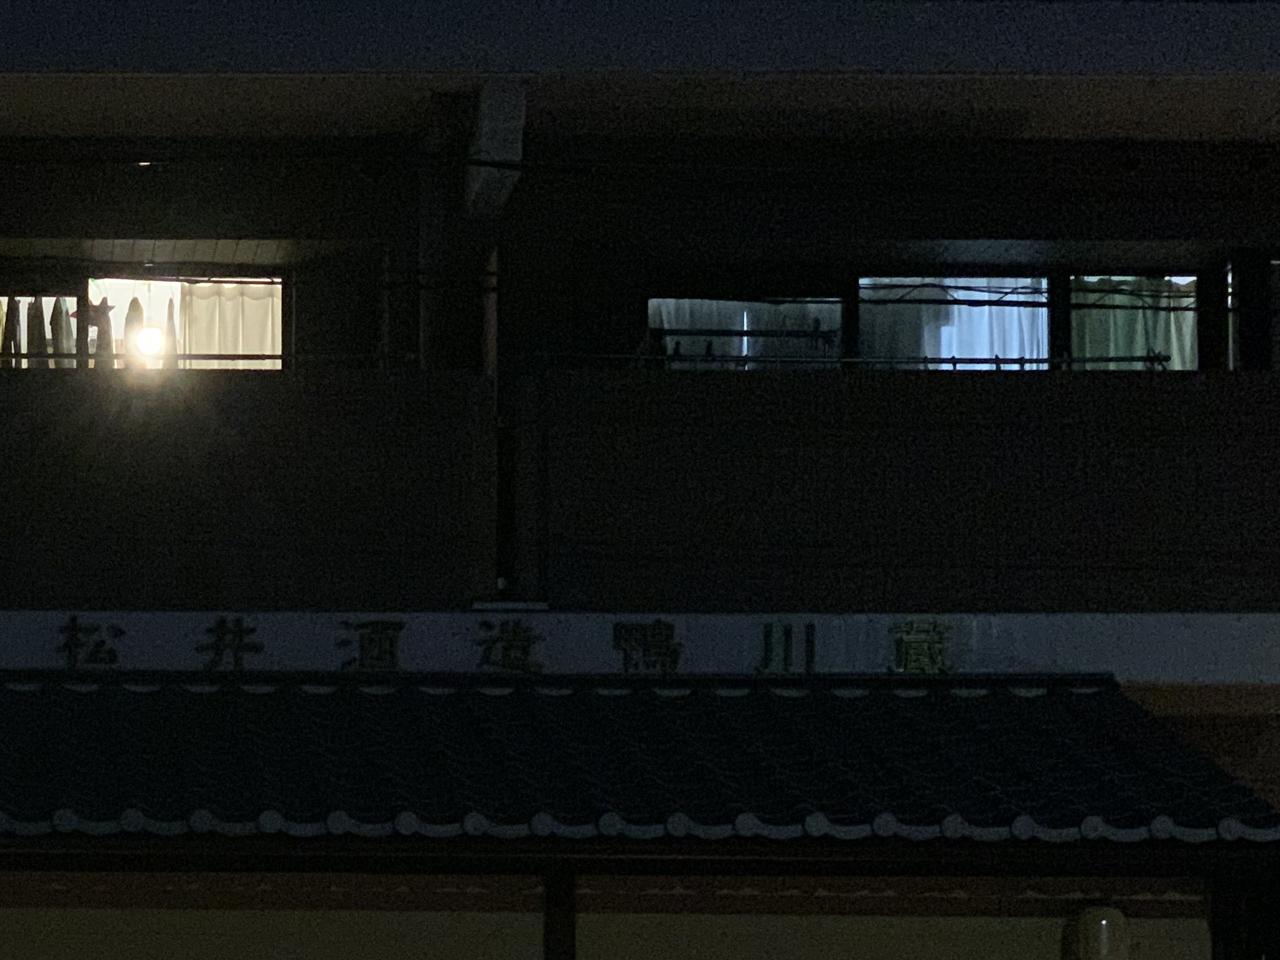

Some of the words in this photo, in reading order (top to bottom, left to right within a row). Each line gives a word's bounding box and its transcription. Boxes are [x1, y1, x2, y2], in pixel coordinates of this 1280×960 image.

[56, 613, 953, 677] 松井酒造鴨川蔵
